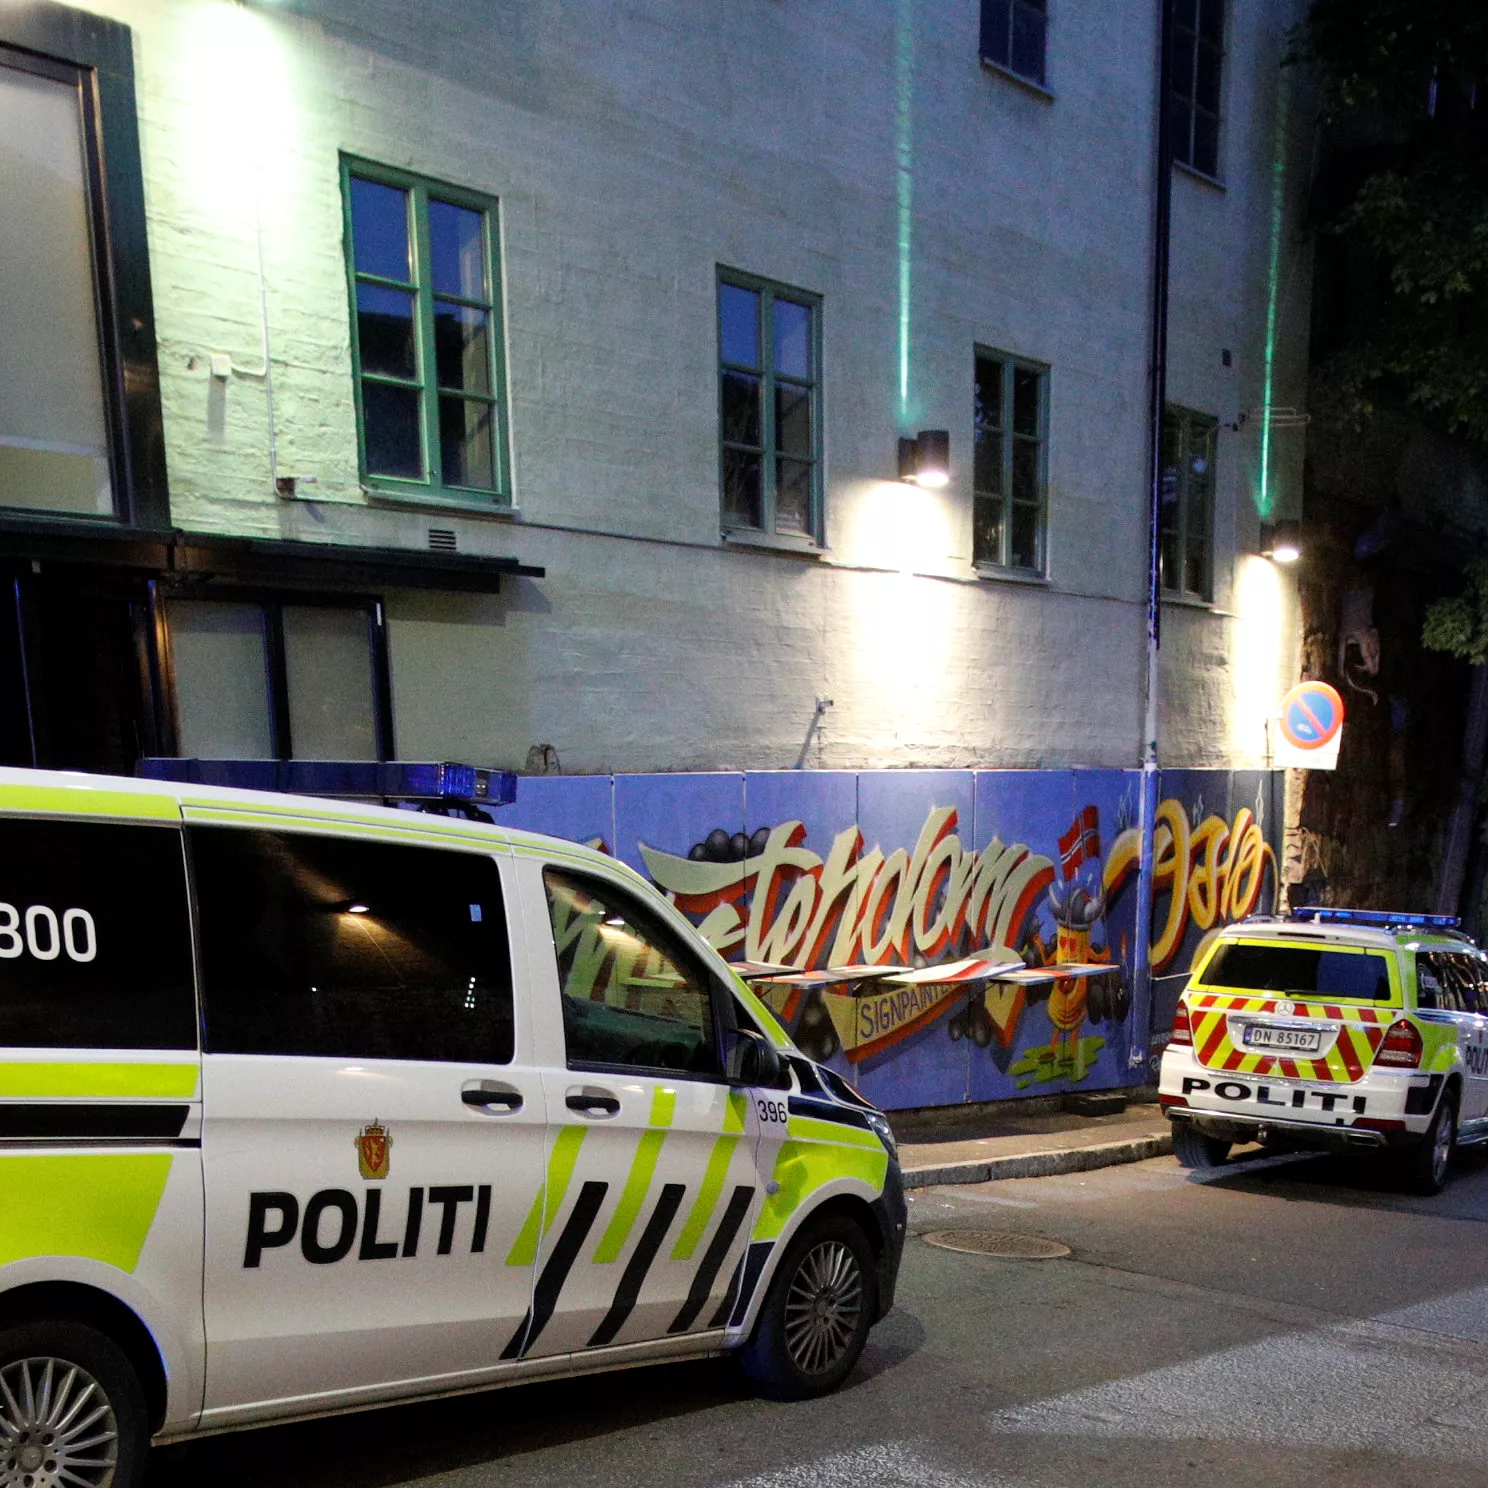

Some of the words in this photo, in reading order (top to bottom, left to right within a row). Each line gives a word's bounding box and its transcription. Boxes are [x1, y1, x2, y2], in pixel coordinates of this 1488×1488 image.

[1253, 1027, 1272, 1043] DN
[1276, 1030, 1315, 1047] 85167
[1182, 1077, 1367, 1114] POLITI
[757, 1099, 788, 1123] 396
[242, 1184, 493, 1270] POLITI
